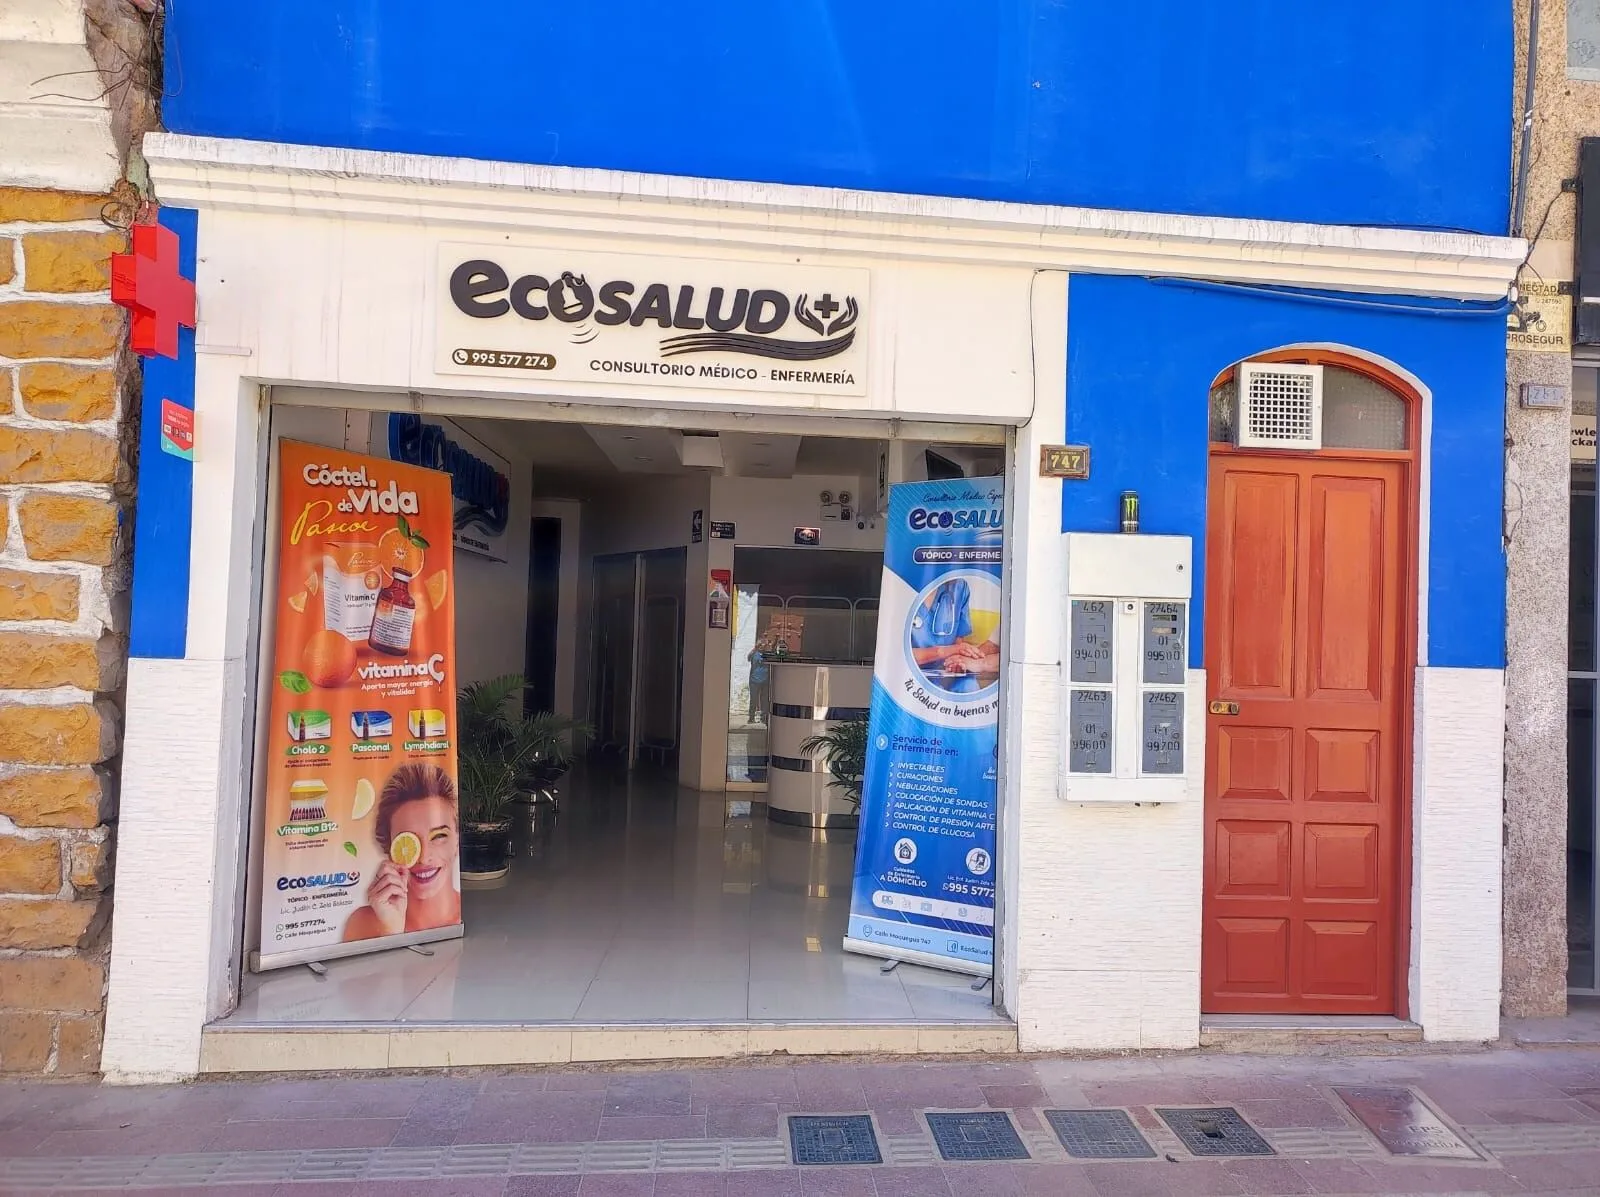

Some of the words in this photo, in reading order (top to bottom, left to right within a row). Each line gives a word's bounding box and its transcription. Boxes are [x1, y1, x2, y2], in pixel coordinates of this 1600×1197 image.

[1520, 284, 1560, 293] NECTAD
[472, 352, 496, 365] 995
[499, 354, 522, 366] 577
[525, 355, 549, 368] 274
[590, 358, 695, 377] CONSULTORIO
[700, 362, 758, 380] MÉDICO
[771, 368, 855, 385] ENFERMERÍA
[1572, 428, 1597, 437] wle
[1051, 454, 1080, 469] 747
[303, 463, 369, 487] Cóctel
[337, 501, 353, 514] de
[348, 480, 419, 514] vida
[290, 500, 379, 545] Pascoe
[922, 550, 953, 560] TÓPICO
[958, 551, 1001, 560] ENFERME
[358, 660, 428, 680] vitamina
[912, 687, 941, 711] Salud
[940, 706, 952, 715] en
[954, 704, 991, 718] buenas
[893, 734, 928, 745] Servicio
[930, 738, 942, 746] de
[319, 744, 326, 754] 2
[352, 742, 390, 752] Pasconal
[897, 762, 945, 773] INYECTABLES
[896, 772, 944, 783] CURACIONES
[896, 782, 959, 795] NEBULIZACIONES
[895, 792, 943, 804] COLOCACIÓN
[956, 799, 989, 809] SONDAS
[939, 806, 950, 815] DE
[951, 808, 989, 820] VITAMINA
[893, 812, 928, 823] CONTROL
[928, 816, 940, 824] DE
[941, 818, 974, 828] PRESIÓN
[892, 822, 927, 833] CONTROL
[928, 826, 940, 834] DE
[940, 828, 976, 838] GLUCOSA
[887, 876, 928, 888] DOMICILIO
[950, 882, 969, 894] 995
[285, 922, 299, 930] 995
[300, 918, 326, 928] 577274
